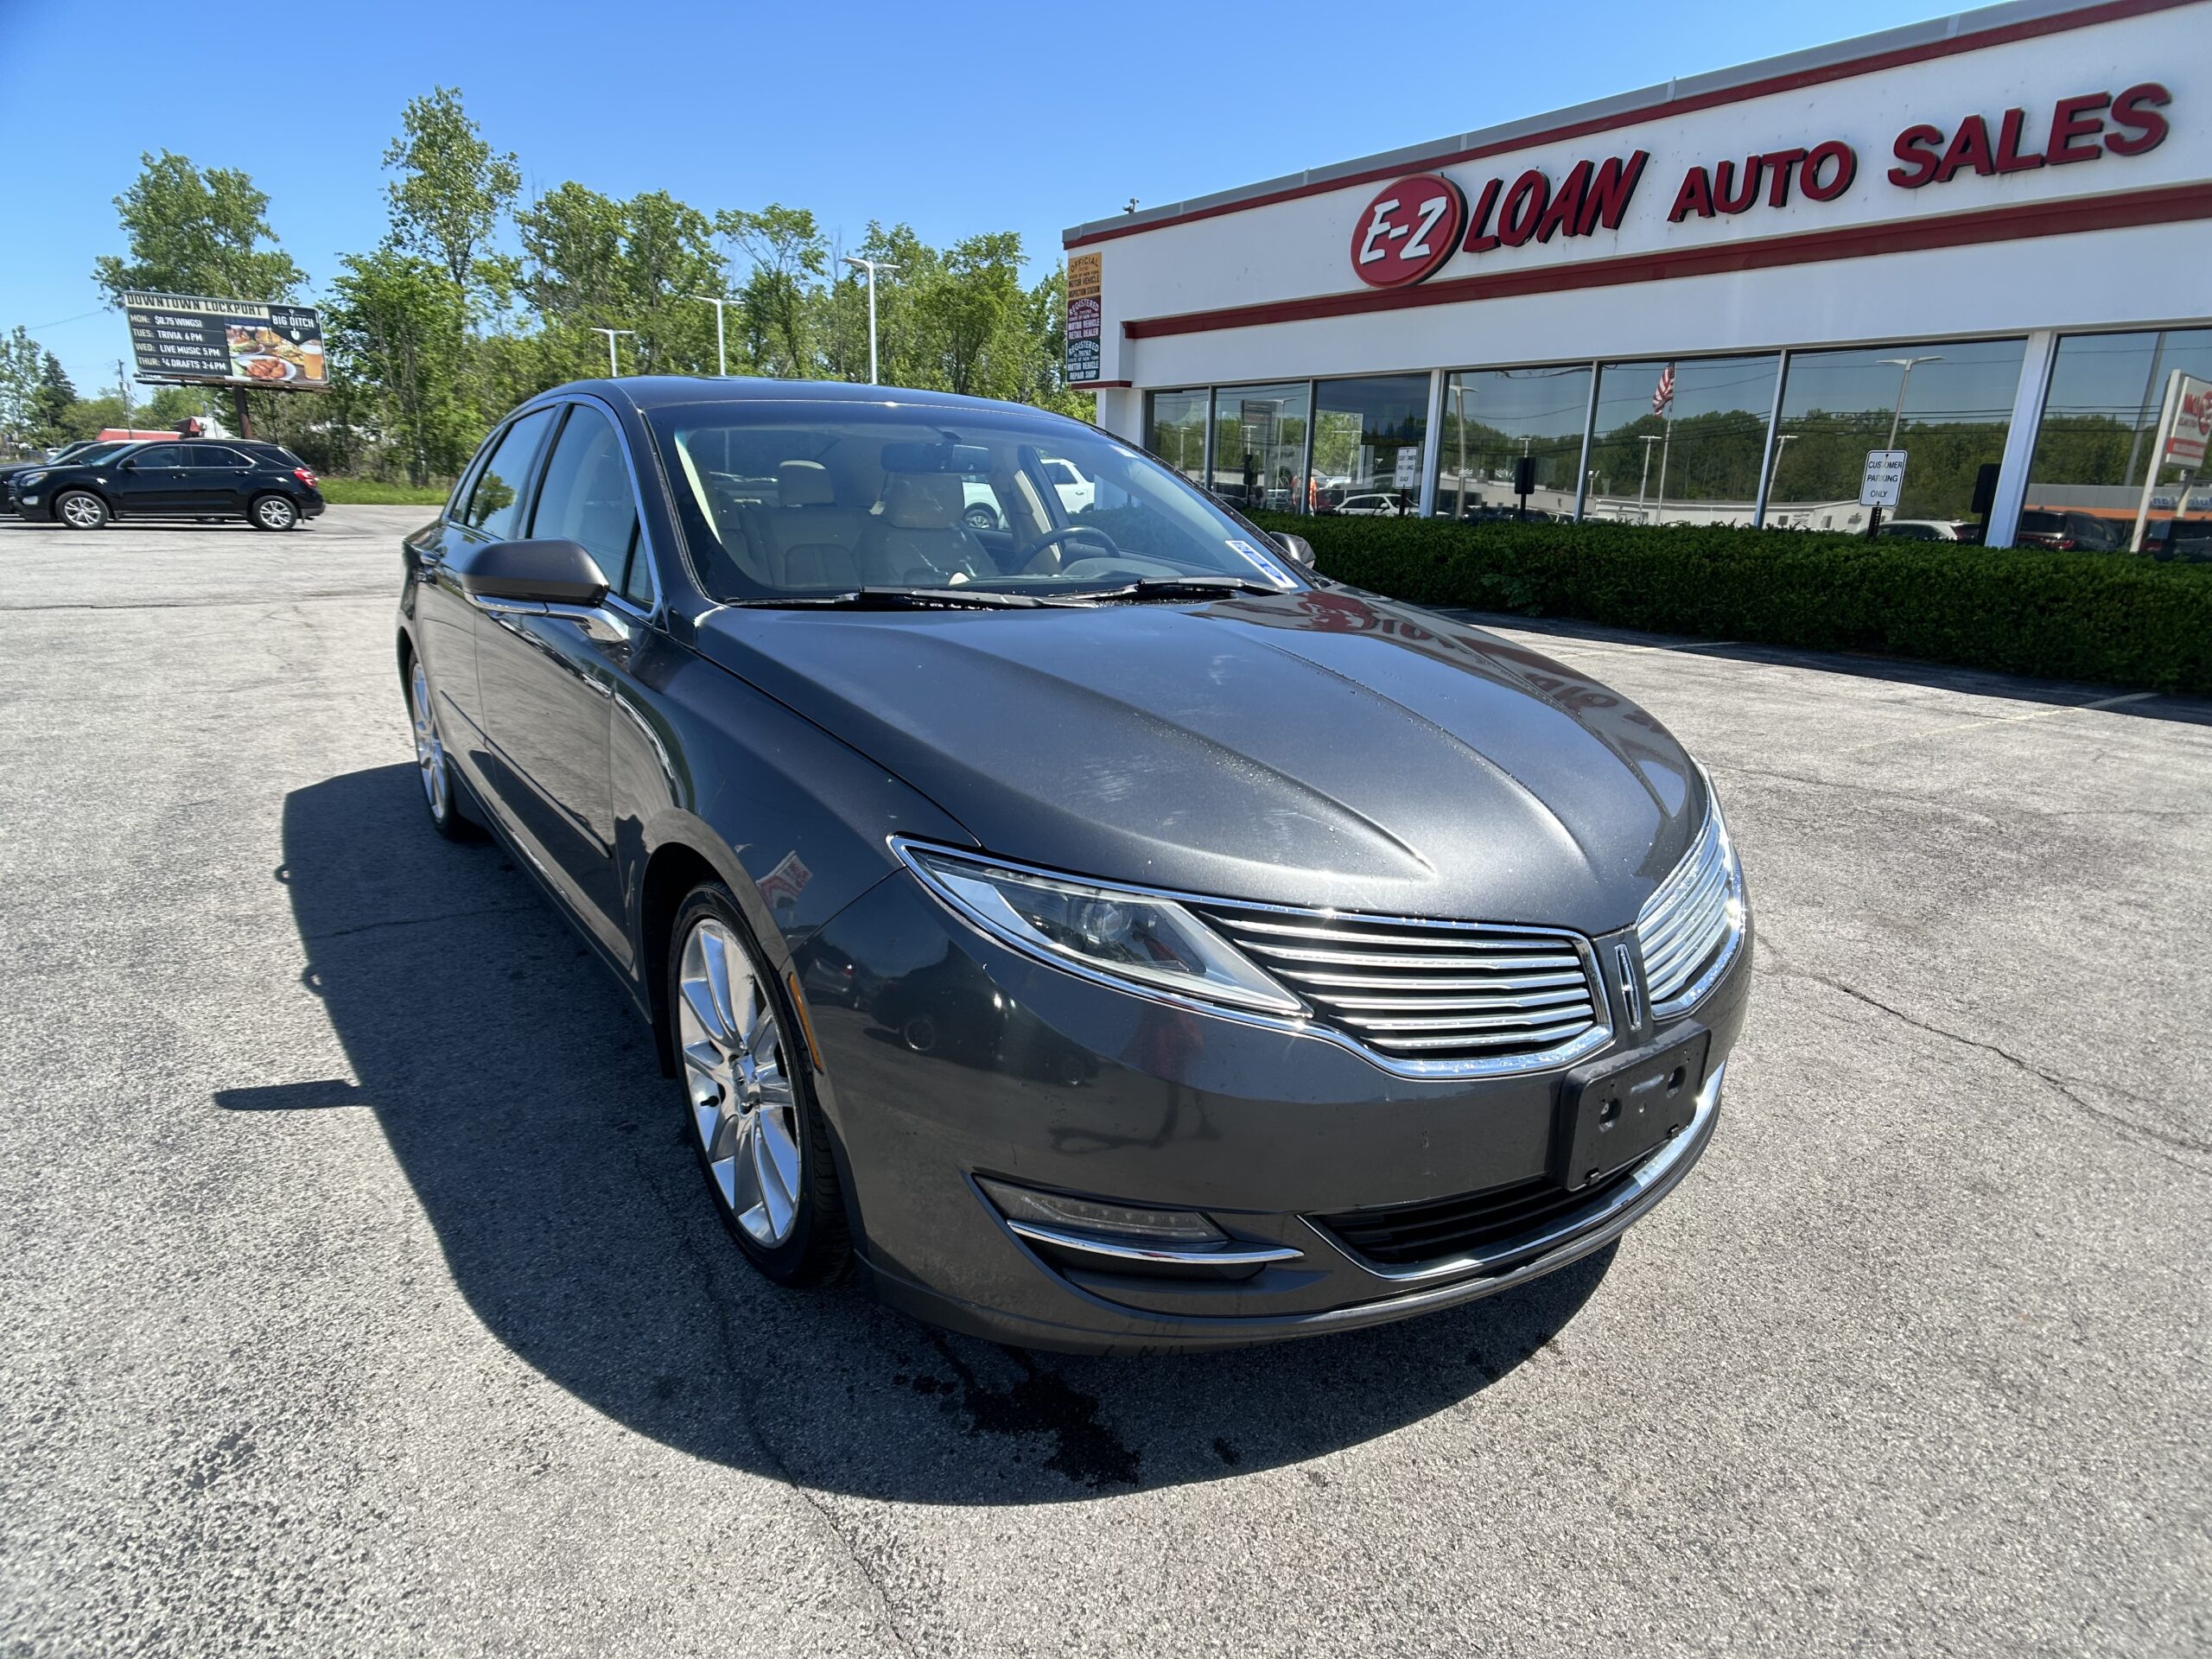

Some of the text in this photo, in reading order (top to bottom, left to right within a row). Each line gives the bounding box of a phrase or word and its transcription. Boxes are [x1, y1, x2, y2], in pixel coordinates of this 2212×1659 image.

[1360, 82, 2171, 264] E-Z LOAN AUTO SALES
[1071, 257, 1098, 272] OFFICIAL
[1069, 275, 1099, 288] MOTOR VEHICLE
[127, 294, 262, 315] DOWNTOWN LOCKPORT
[1069, 298, 1099, 316] REGISTERED
[130, 315, 202, 327] MON: $0.75 WINGS!
[272, 315, 315, 327] BIG DITCH
[1083, 318, 1099, 328] VEHICLE
[132, 328, 154, 338] TUES:
[156, 330, 182, 340] TRIVIA
[185, 332, 190, 340] 6
[1083, 327, 1099, 337] DEALER
[135, 342, 156, 352] WED:
[159, 344, 176, 353] LIVE
[176, 346, 200, 355] MUSIC
[208, 348, 220, 357] PM
[1069, 340, 1099, 355] REGISTERED
[138, 356, 161, 366] THUR:
[162, 358, 170, 366] $4
[171, 359, 200, 369] DRAFTS
[214, 361, 226, 370] PM
[1083, 360, 1098, 370] VEHICLE
[1085, 370, 1096, 378] SHOP
